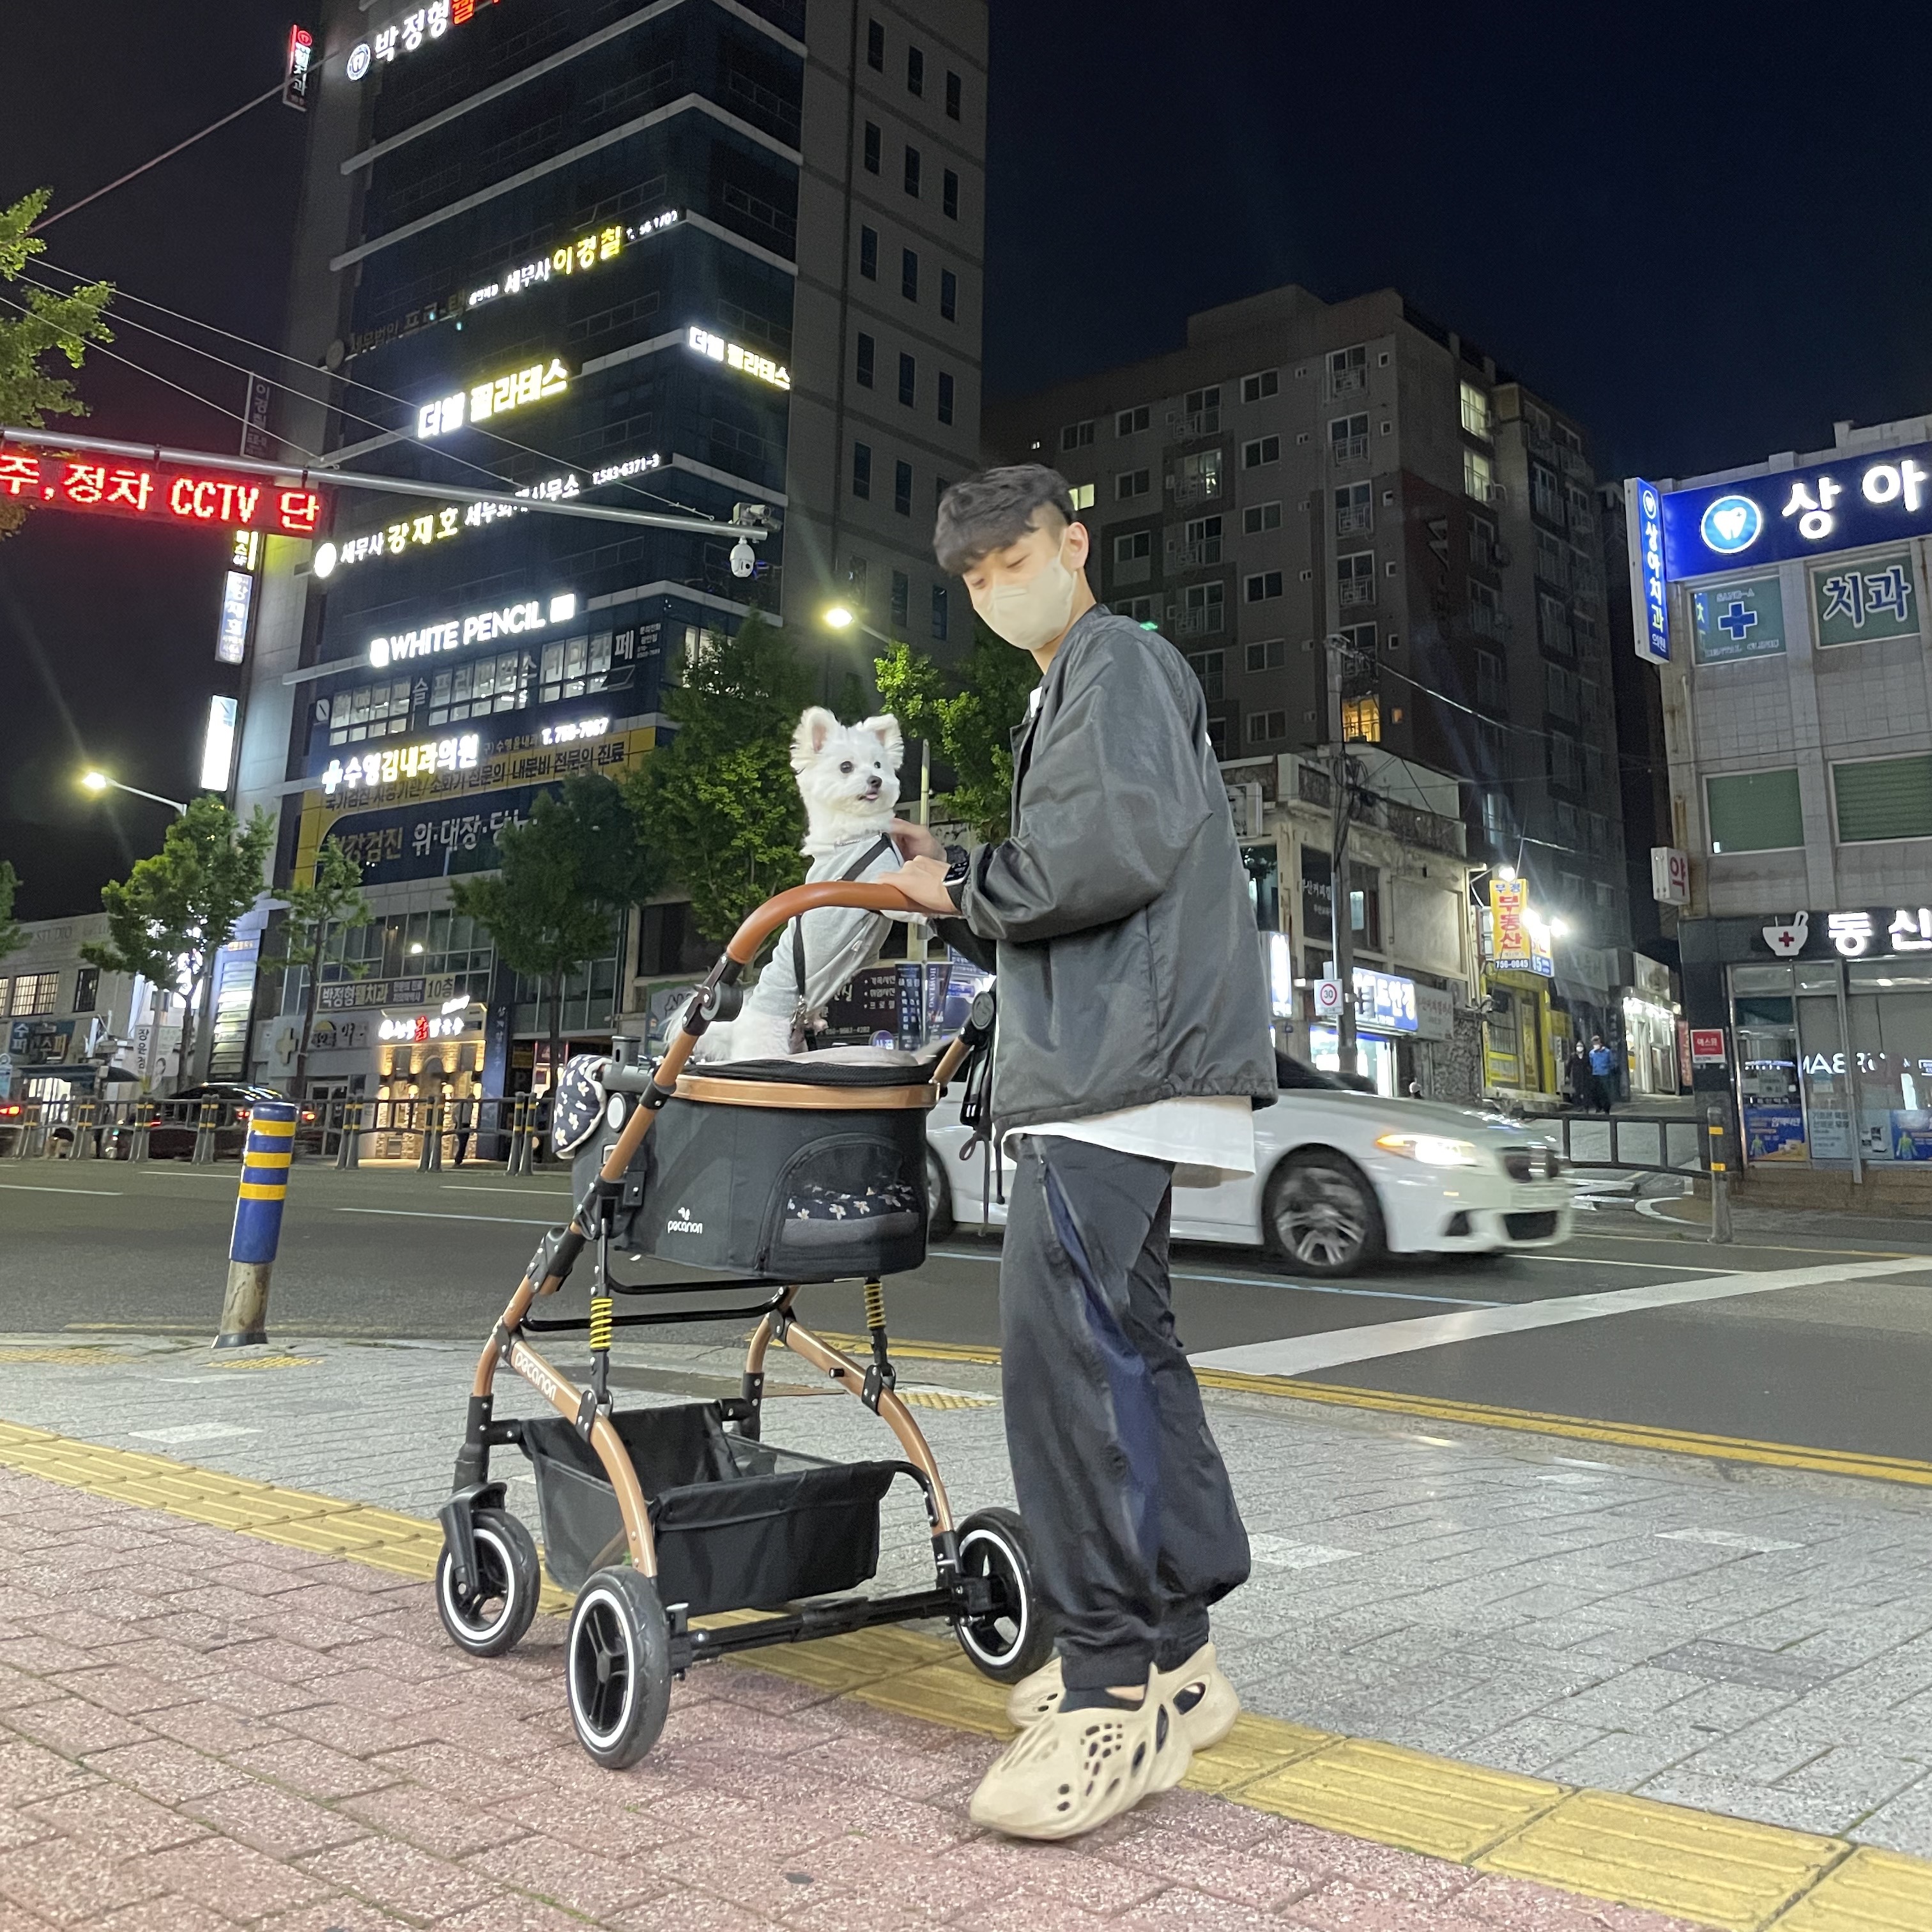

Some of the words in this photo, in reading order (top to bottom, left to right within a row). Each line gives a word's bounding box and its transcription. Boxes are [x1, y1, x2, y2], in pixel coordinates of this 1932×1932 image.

[503, 257, 551, 294] 세무사
[552, 225, 622, 275] 이경칠
[469, 358, 569, 424] 필라테스
[726, 342, 792, 392] 필라테스
[170, 476, 259, 524] CCTV
[280, 491, 321, 532] 단
[1781, 459, 1927, 540] 상아
[339, 532, 385, 565] 세무사
[387, 506, 460, 555] 강재호
[1645, 521, 1664, 634] 상아치과
[1822, 564, 1912, 629] 치과
[390, 619, 460, 662] WHITE
[463, 601, 546, 646] PENCIL
[1651, 632, 1667, 653] 의원
[342, 733, 479, 790] 수영김내과의원
[512, 753, 552, 780] 내분비
[554, 746, 594, 774] 전문의
[597, 740, 625, 767] 진료
[337, 825, 404, 864] 강검진
[1669, 856, 1686, 897] 약
[1498, 894, 1522, 950] 부동산
[1827, 907, 1932, 957] 동신
[427, 978, 454, 999] 10층
[1323, 989, 1334, 999] 30
